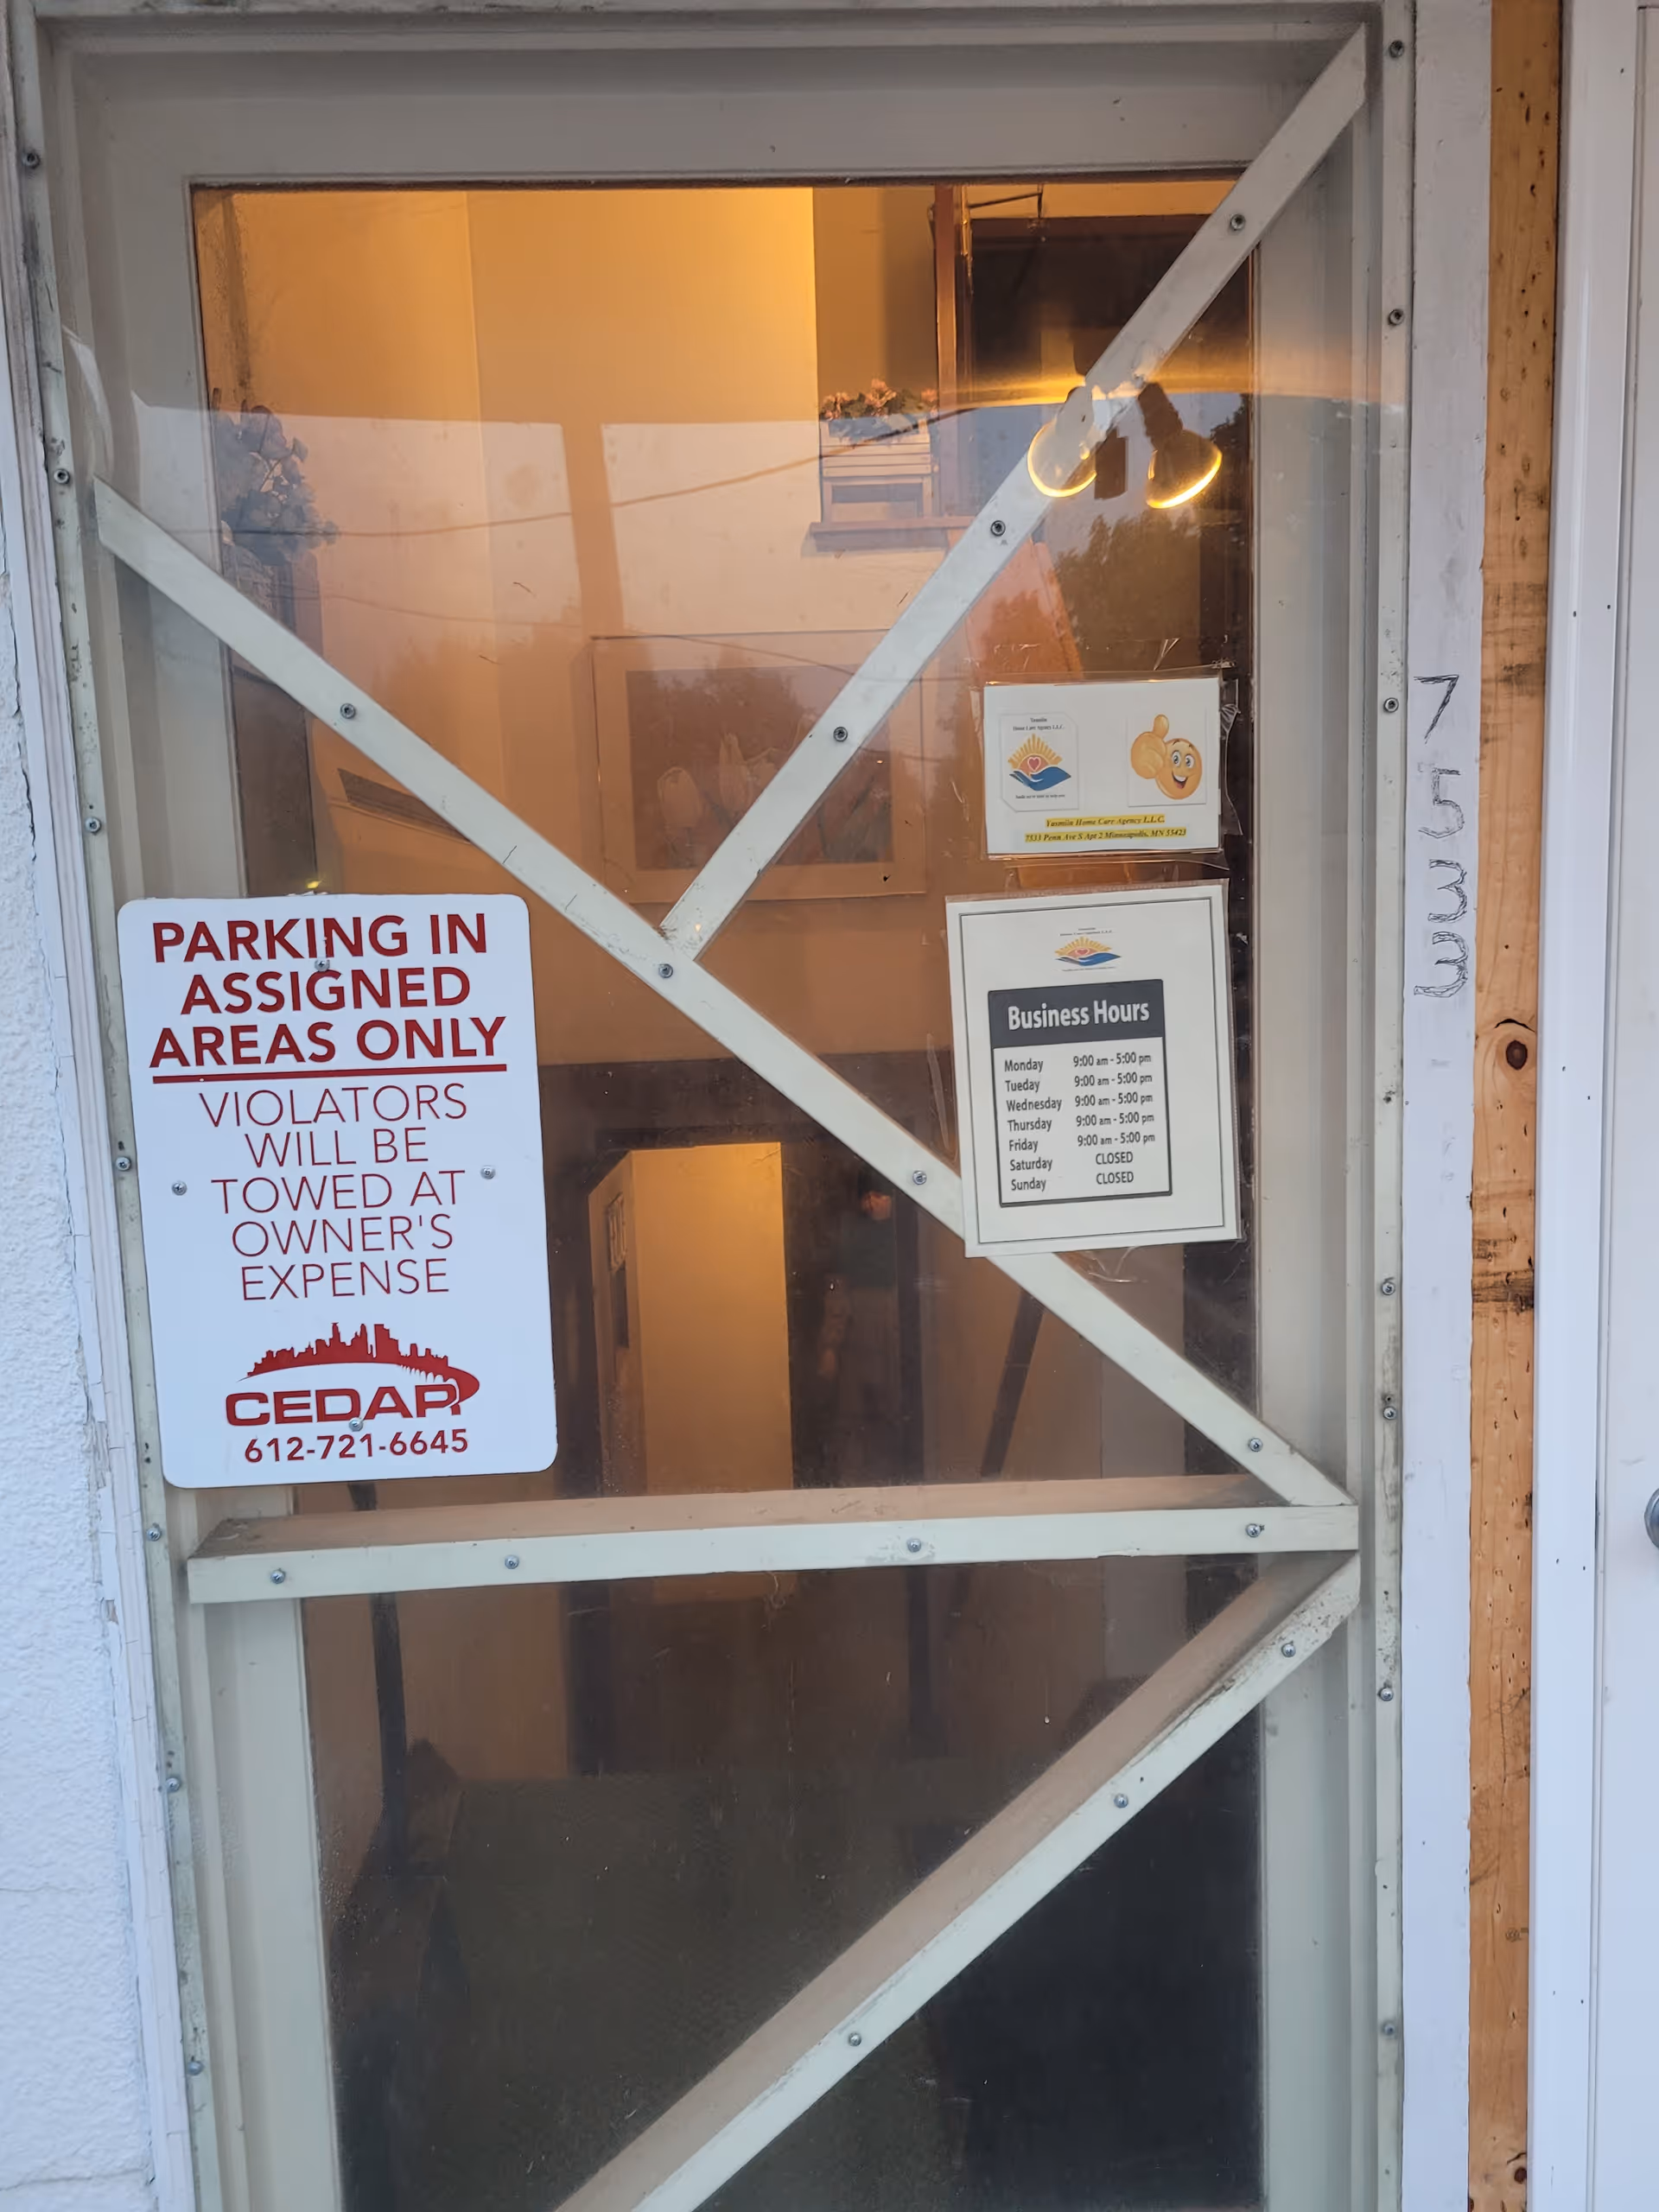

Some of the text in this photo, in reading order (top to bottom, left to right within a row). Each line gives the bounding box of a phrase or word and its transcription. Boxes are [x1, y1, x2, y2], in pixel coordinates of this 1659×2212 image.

[1043, 833, 1062, 842] Penn
[1063, 833, 1077, 842] Ave
[1084, 832, 1098, 841] Apt
[1098, 831, 1104, 840] 2
[1150, 829, 1164, 837] MN
[1165, 828, 1187, 837] 55423
[1075, 817, 1096, 827] Home
[1116, 817, 1141, 826] Agency
[152, 912, 488, 963] PARKING IN
[180, 966, 471, 1015] ASSIGNED
[1007, 999, 1150, 1031] Business Hours
[149, 1015, 507, 1069] AREAS ONLY
[1004, 1058, 1044, 1072] Monday
[1072, 1054, 1094, 1067] 9:00
[1096, 1057, 1109, 1066] am
[1116, 1052, 1137, 1064] 5:00
[1138, 1054, 1152, 1065] pm
[1005, 1078, 1040, 1093] Tueday
[1074, 1074, 1096, 1087] 9:00
[1096, 1077, 1109, 1086] am
[1117, 1071, 1138, 1084] 5:00
[1140, 1074, 1153, 1085] pm
[198, 1082, 467, 1128] VIOLATORS
[1006, 1096, 1062, 1112] Wednesday
[1074, 1094, 1096, 1107] 9:00
[1097, 1097, 1110, 1106] am
[1117, 1091, 1138, 1104] 5:00
[1140, 1094, 1154, 1106] pm
[1007, 1116, 1052, 1133] Thursday
[1076, 1114, 1097, 1127] 9:00
[1099, 1116, 1111, 1126] am
[1119, 1111, 1140, 1124] 5:00
[1141, 1114, 1154, 1125] pm
[243, 1126, 429, 1168] WILL BE
[1008, 1138, 1039, 1153] Friday
[1077, 1134, 1098, 1147] 9:00
[1100, 1136, 1113, 1146] am
[1120, 1131, 1141, 1144] 5:00
[1142, 1133, 1155, 1146] pm
[1009, 1151, 1134, 1172] Saturday CLOSED
[210, 1169, 467, 1214] TOWED AT
[1010, 1171, 1135, 1192] Sunday CLOSED
[231, 1212, 454, 1258] OWNER'S
[241, 1258, 450, 1302] EXPENSE
[244, 1428, 469, 1464] 612-721-6645
